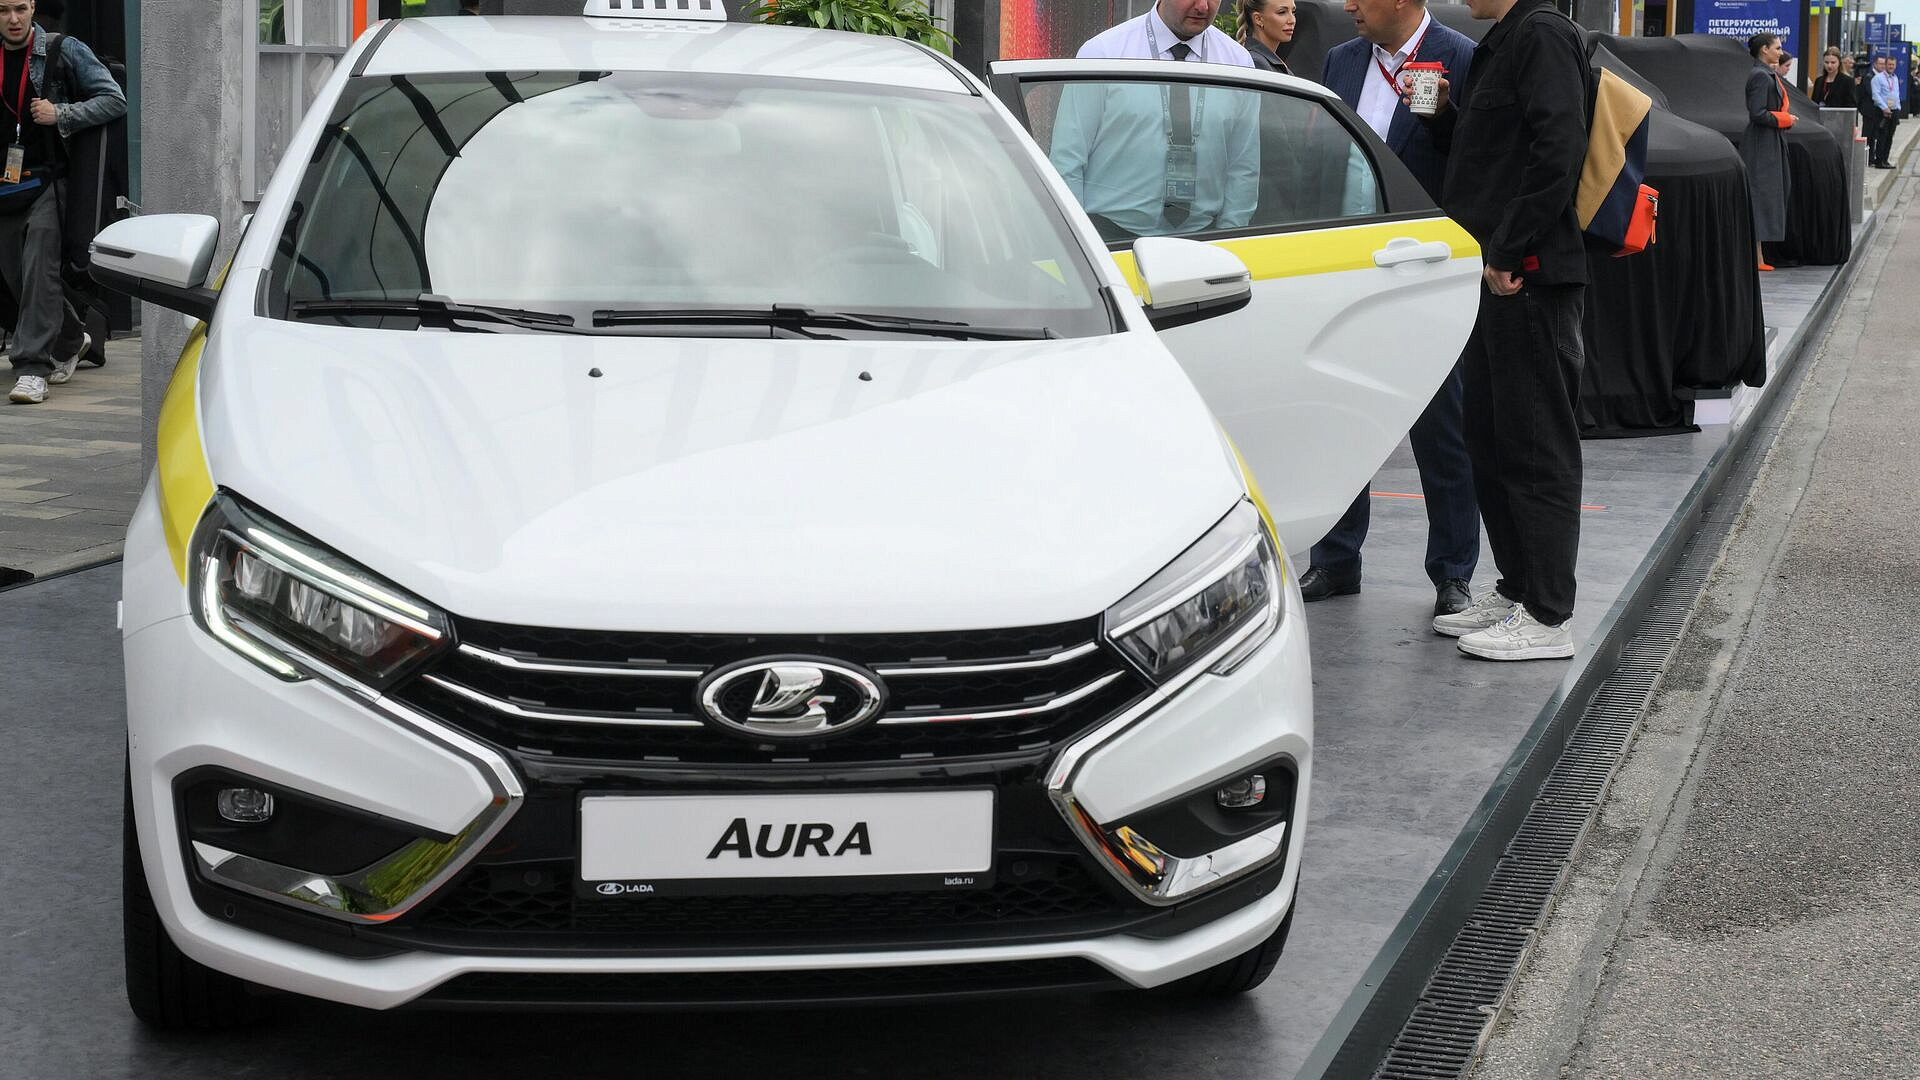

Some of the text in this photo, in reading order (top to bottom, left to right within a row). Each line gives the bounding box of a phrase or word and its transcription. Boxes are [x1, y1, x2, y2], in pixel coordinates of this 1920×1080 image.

[1708, 18, 1779, 27] ПЕТЕРБУРГСКИЙ
[944, 877, 974, 886] lada.ru
[626, 884, 655, 893] LADA
